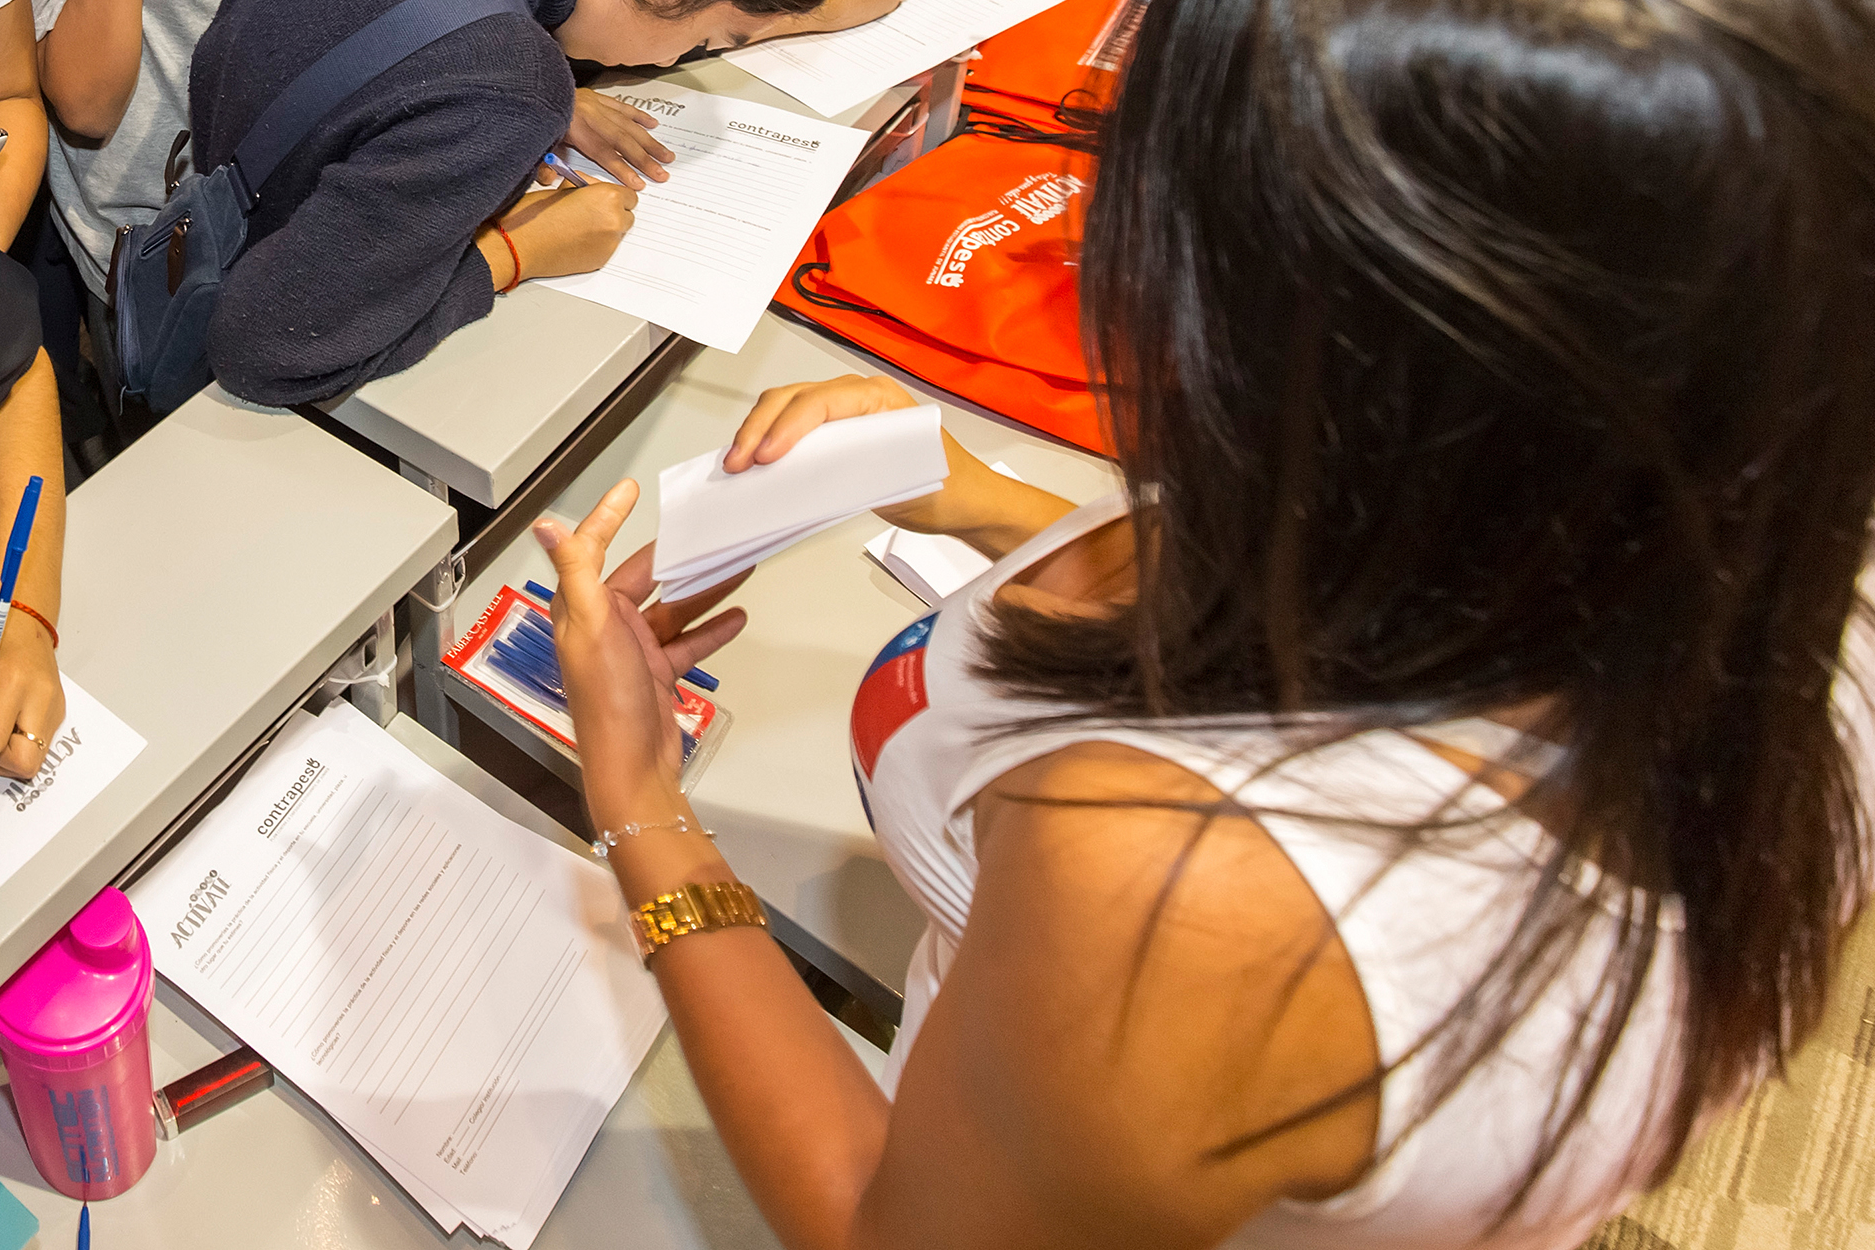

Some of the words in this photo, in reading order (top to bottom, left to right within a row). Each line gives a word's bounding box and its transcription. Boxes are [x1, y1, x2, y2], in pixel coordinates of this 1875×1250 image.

[726, 118, 822, 150] contrapeso
[446, 594, 504, 659] FABER-CASTELL
[257, 758, 321, 836] contrapeso
